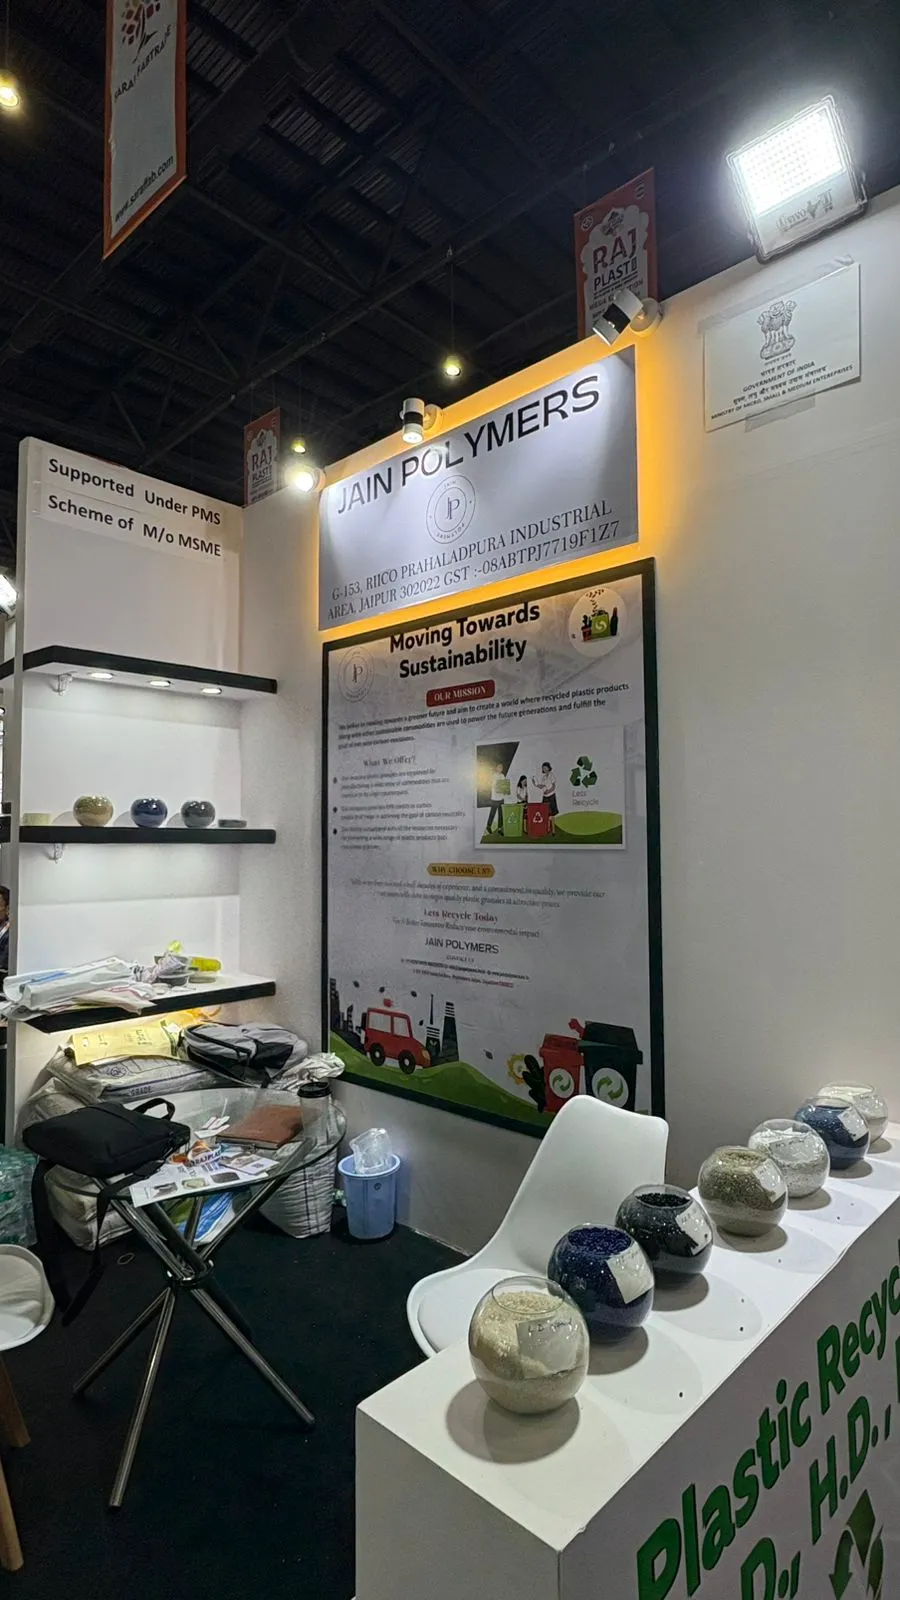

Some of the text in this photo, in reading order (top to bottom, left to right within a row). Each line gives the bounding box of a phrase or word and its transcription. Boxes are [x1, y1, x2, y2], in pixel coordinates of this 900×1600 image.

[592, 228, 638, 275] RAJ
[711, 407, 735, 420] MINISTRY
[735, 404, 743, 412] OF
[763, 391, 781, 401] SMALL
[787, 379, 812, 393] MEDIUM
[742, 372, 786, 393] GOVERNMENT
[796, 360, 816, 371] INDIA
[252, 446, 273, 473] RAJ
[337, 374, 600, 515] JAIN POLYMERS
[48, 458, 222, 526] Supported Under PMS
[48, 495, 222, 557] Scheme of M/o MSME
[332, 500, 613, 601] G-153, RIICO PRAHALADPURA INDUSTRIAL
[327, 602, 357, 621] AREA,
[358, 588, 397, 613] JAIPUR
[400, 575, 440, 600] 302022
[443, 565, 471, 586] GST
[389, 602, 541, 653] Moving Towards
[399, 637, 528, 679] Sustainability
[434, 686, 487, 702] OUR MISSION
[476, 702, 495, 710] create
[500, 698, 519, 709] world
[520, 696, 541, 705] where
[541, 690, 570, 702] recycled
[571, 687, 595, 699] plastic
[596, 683, 630, 696] products
[487, 713, 497, 721] the
[498, 711, 518, 720] future
[519, 706, 557, 718] generations
[558, 703, 573, 712] and
[573, 700, 592, 710] fulfill
[593, 698, 606, 707] the
[441, 909, 472, 920] Recycle
[473, 911, 498, 924] Today
[425, 937, 500, 955] JAIN POLYMERS
[816, 1239, 900, 1417] Recyc
[636, 1379, 812, 1600] Plastic
[808, 1395, 892, 1546] H.D.,
